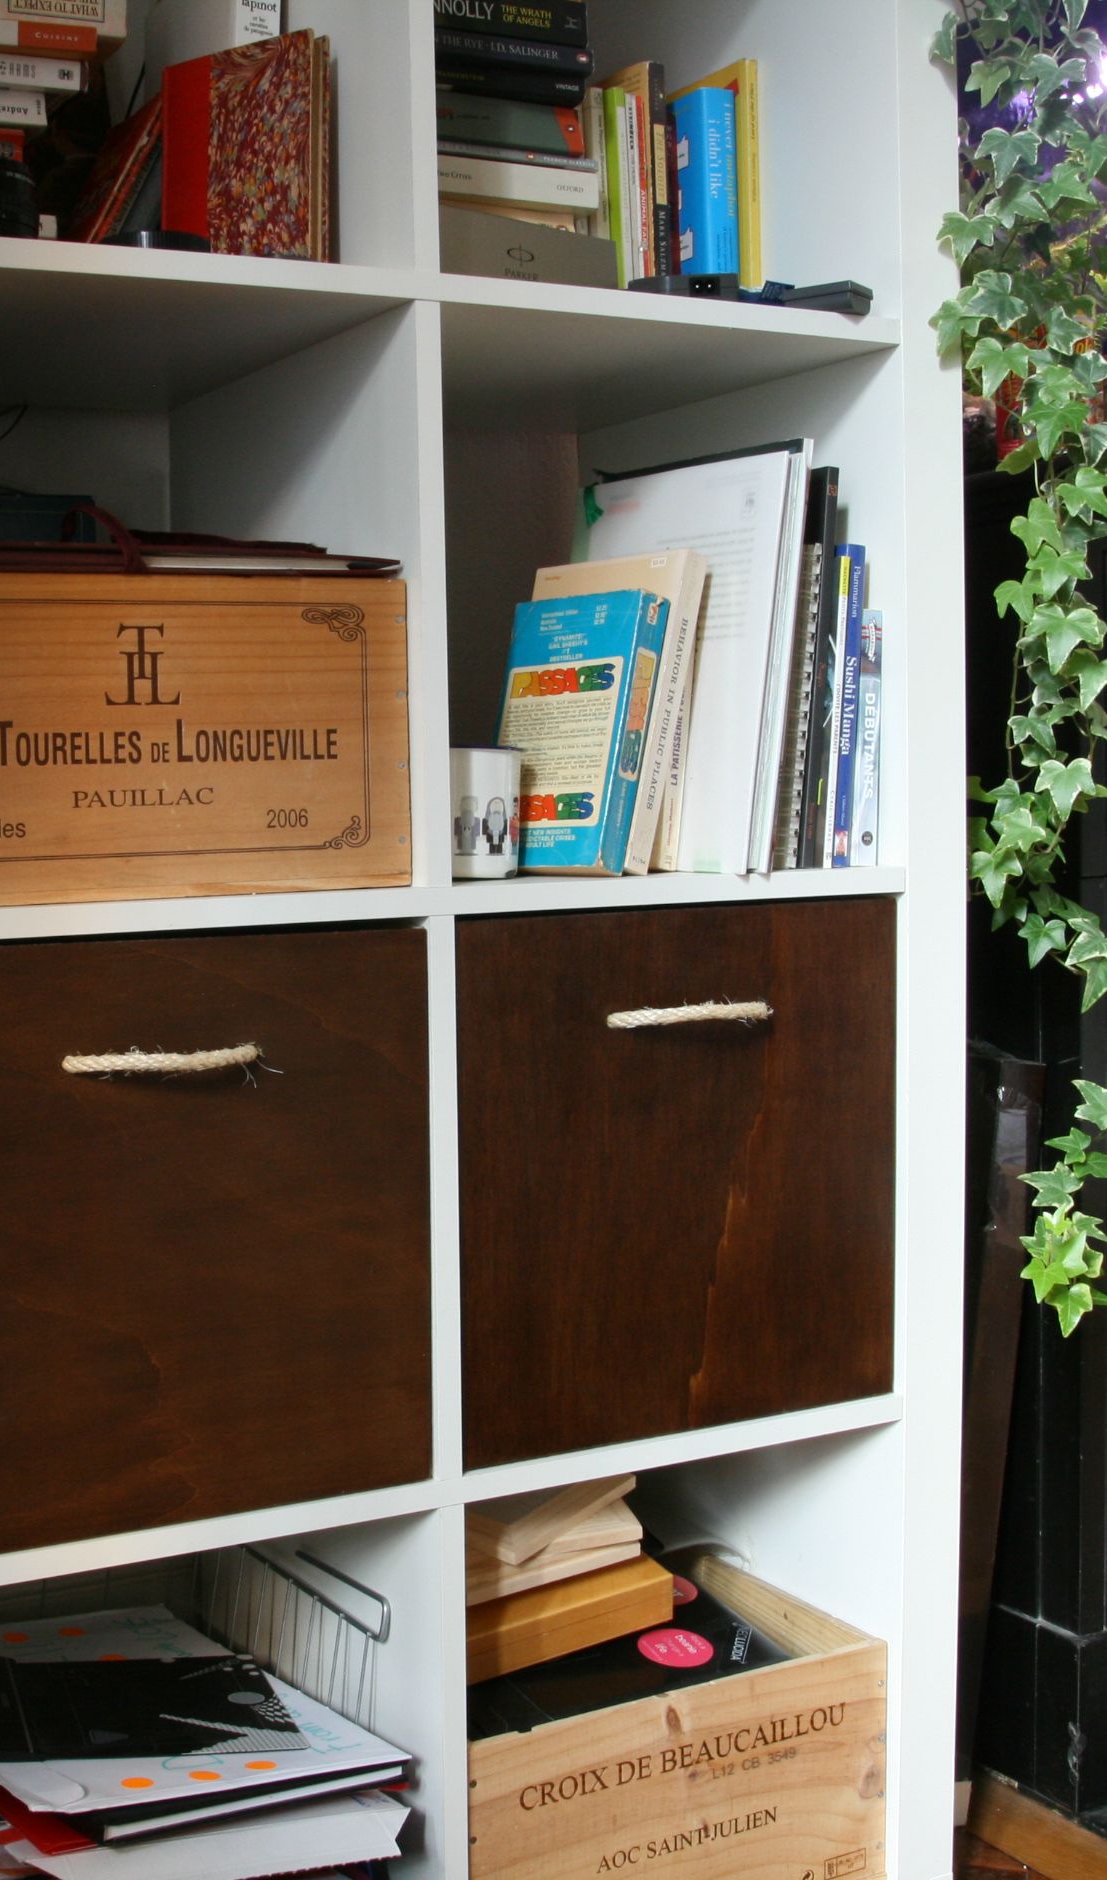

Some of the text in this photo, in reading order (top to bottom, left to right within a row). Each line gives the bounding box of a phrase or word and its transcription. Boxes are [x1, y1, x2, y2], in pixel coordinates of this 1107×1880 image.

[14, 0, 99, 17] WHAT TO EXPECT
[500, 4, 553, 21] THE WRATH
[502, 15, 551, 29] OF ANGELS
[34, 31, 80, 42] CUISINE
[443, 34, 462, 48] THE
[463, 37, 482, 50] RYE
[508, 43, 559, 61] SALINGER
[8, 62, 37, 79] ARMS
[555, 82, 580, 92] VINTAGE
[627, 106, 635, 150] STEINBECK
[723, 111, 733, 152] never
[708, 128, 721, 168] didn't
[556, 184, 584, 193] OXFORD
[708, 172, 722, 199] like
[640, 188, 648, 225] ANIMAL
[658, 210, 667, 237] MARK
[504, 267, 539, 281] PARKER
[851, 566, 862, 618] Flammarion
[671, 618, 689, 688] BEHAVIOR
[667, 688, 675, 704] IN
[840, 655, 857, 756] Sushi Manga
[150, 742, 171, 763] DE
[175, 718, 339, 763] LONGUEVILLE
[657, 708, 672, 757] PUBLIC
[863, 692, 876, 801] DÉBUTANTS
[645, 759, 662, 811] PLACES
[670, 773, 679, 787] LA
[72, 787, 215, 809] PAUILLAC
[265, 808, 310, 829] 2006
[518, 1701, 848, 1812] CROIX DE BEAUCAILLOU
[595, 1844, 642, 1875] AOC
